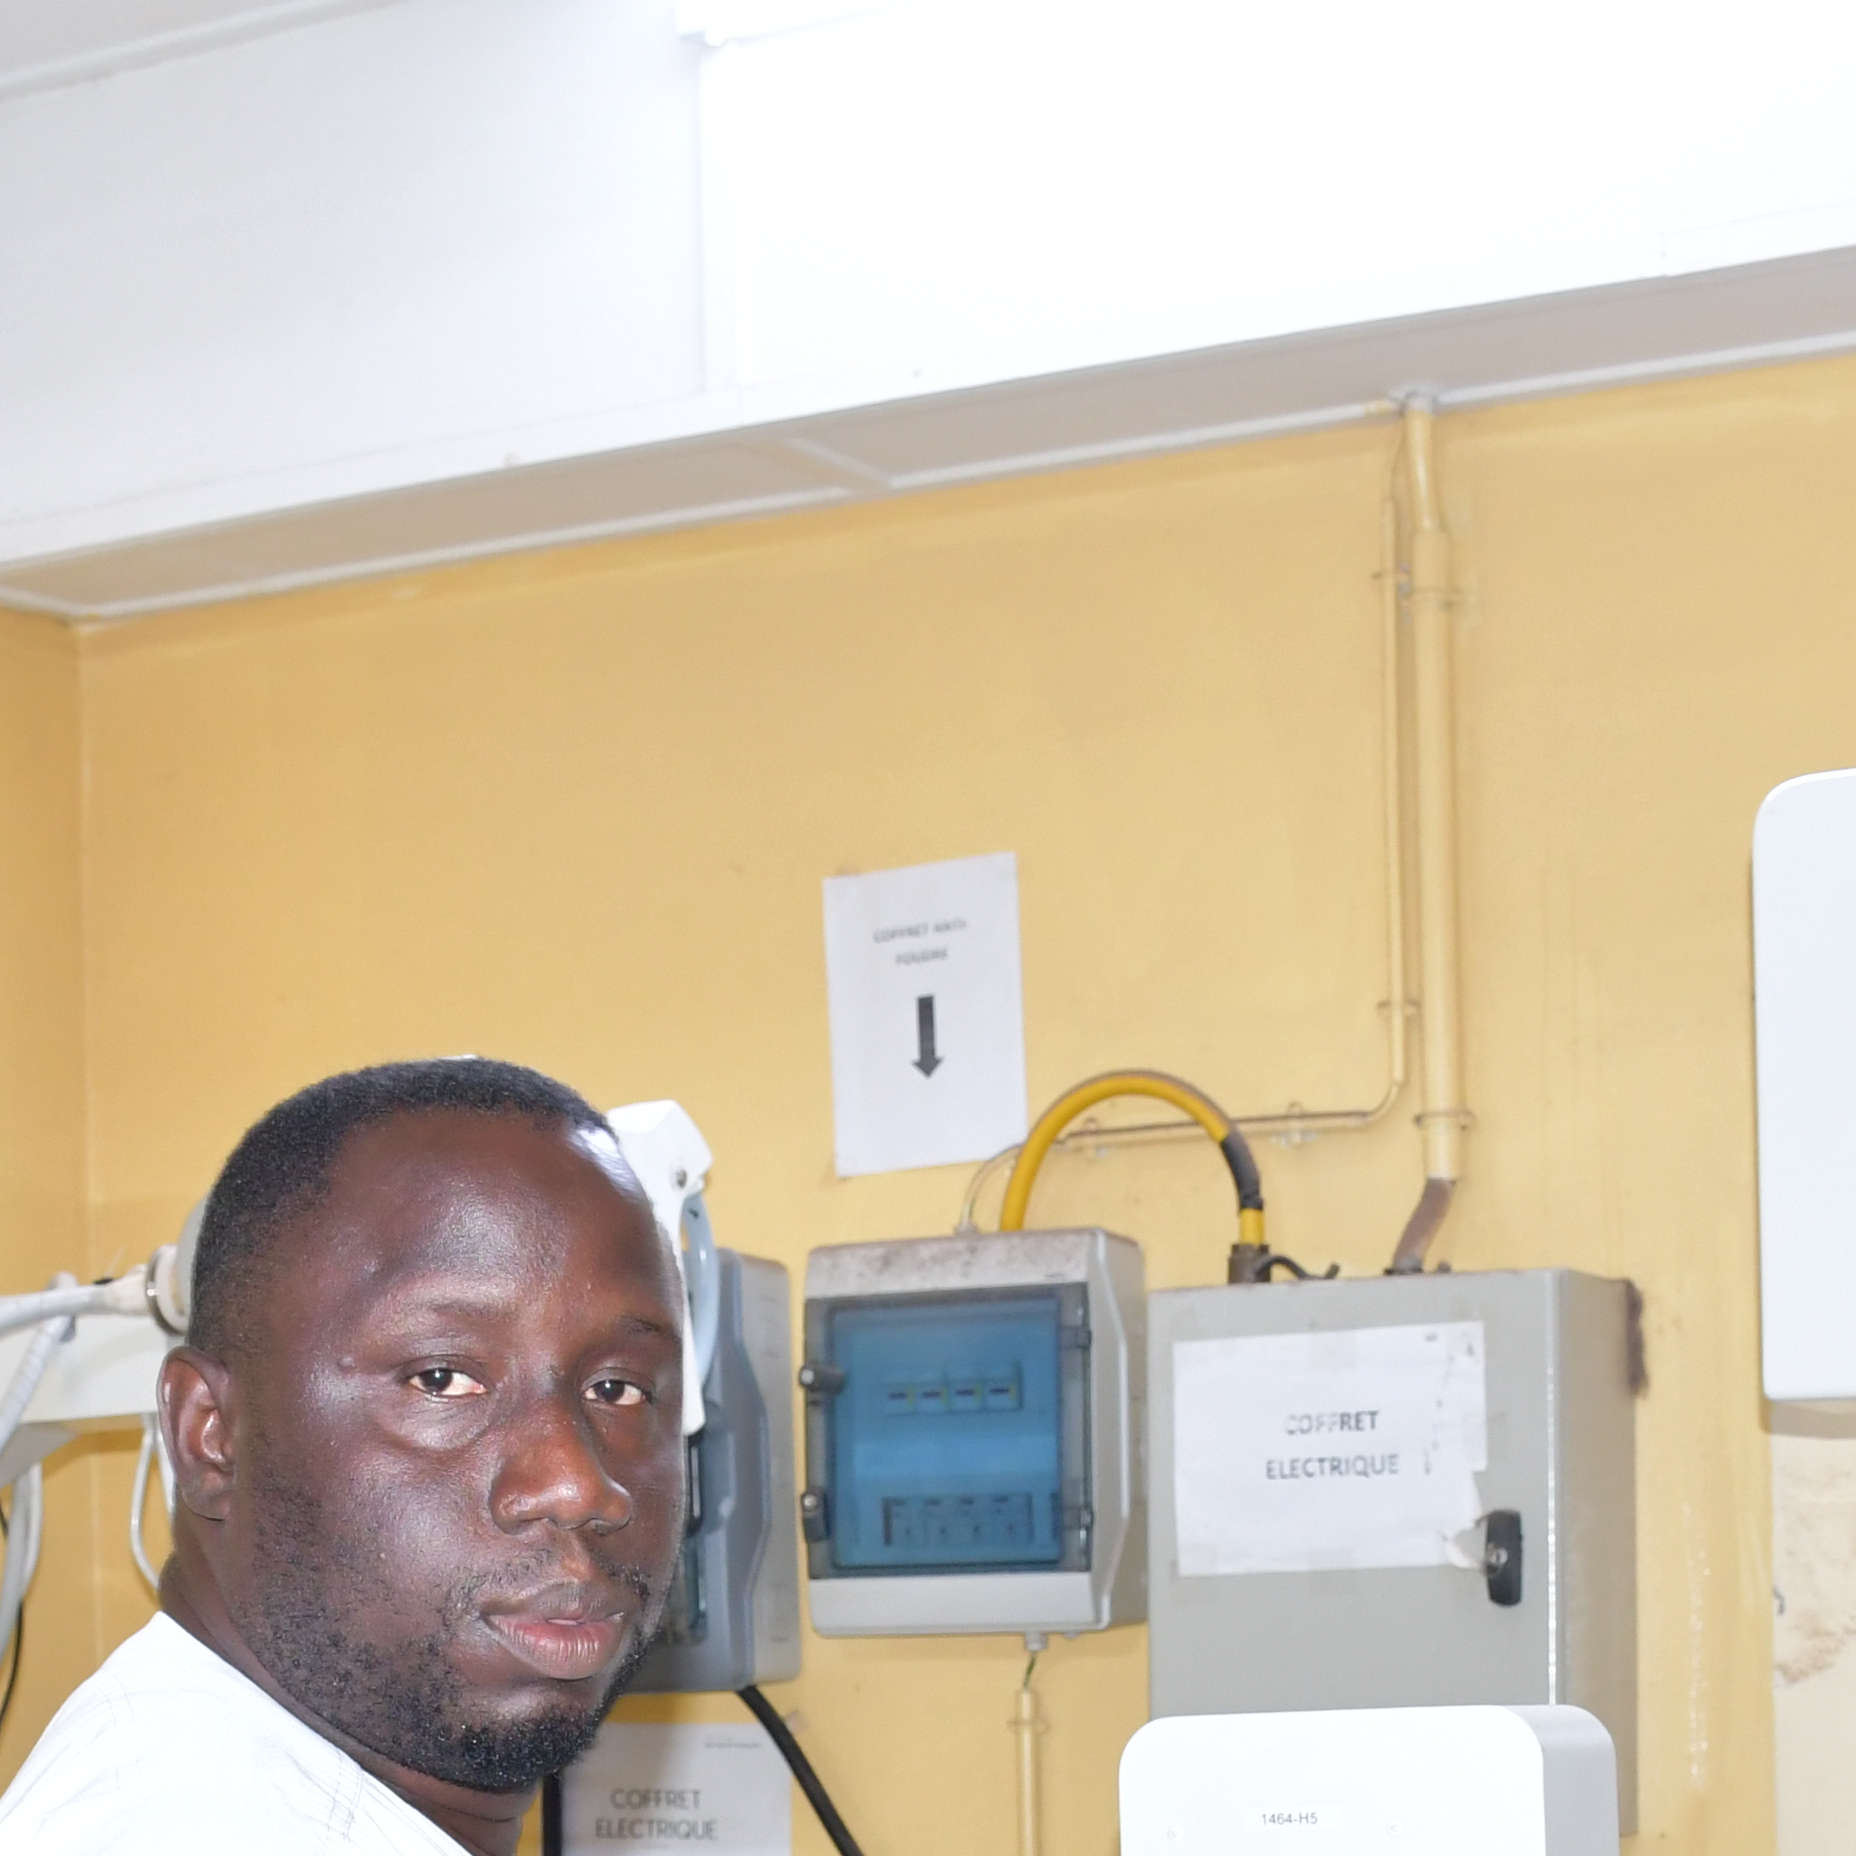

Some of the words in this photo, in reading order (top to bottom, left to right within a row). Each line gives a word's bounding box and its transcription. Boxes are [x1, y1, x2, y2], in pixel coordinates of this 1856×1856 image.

[1286, 1411, 1379, 1435] COFFRET
[1266, 1454, 1399, 1479] ELECTRIQUE
[610, 1789, 702, 1810] COFFRET
[595, 1818, 717, 1840] ELECTRIQUE
[1260, 1811, 1318, 1825] 1464-H5
